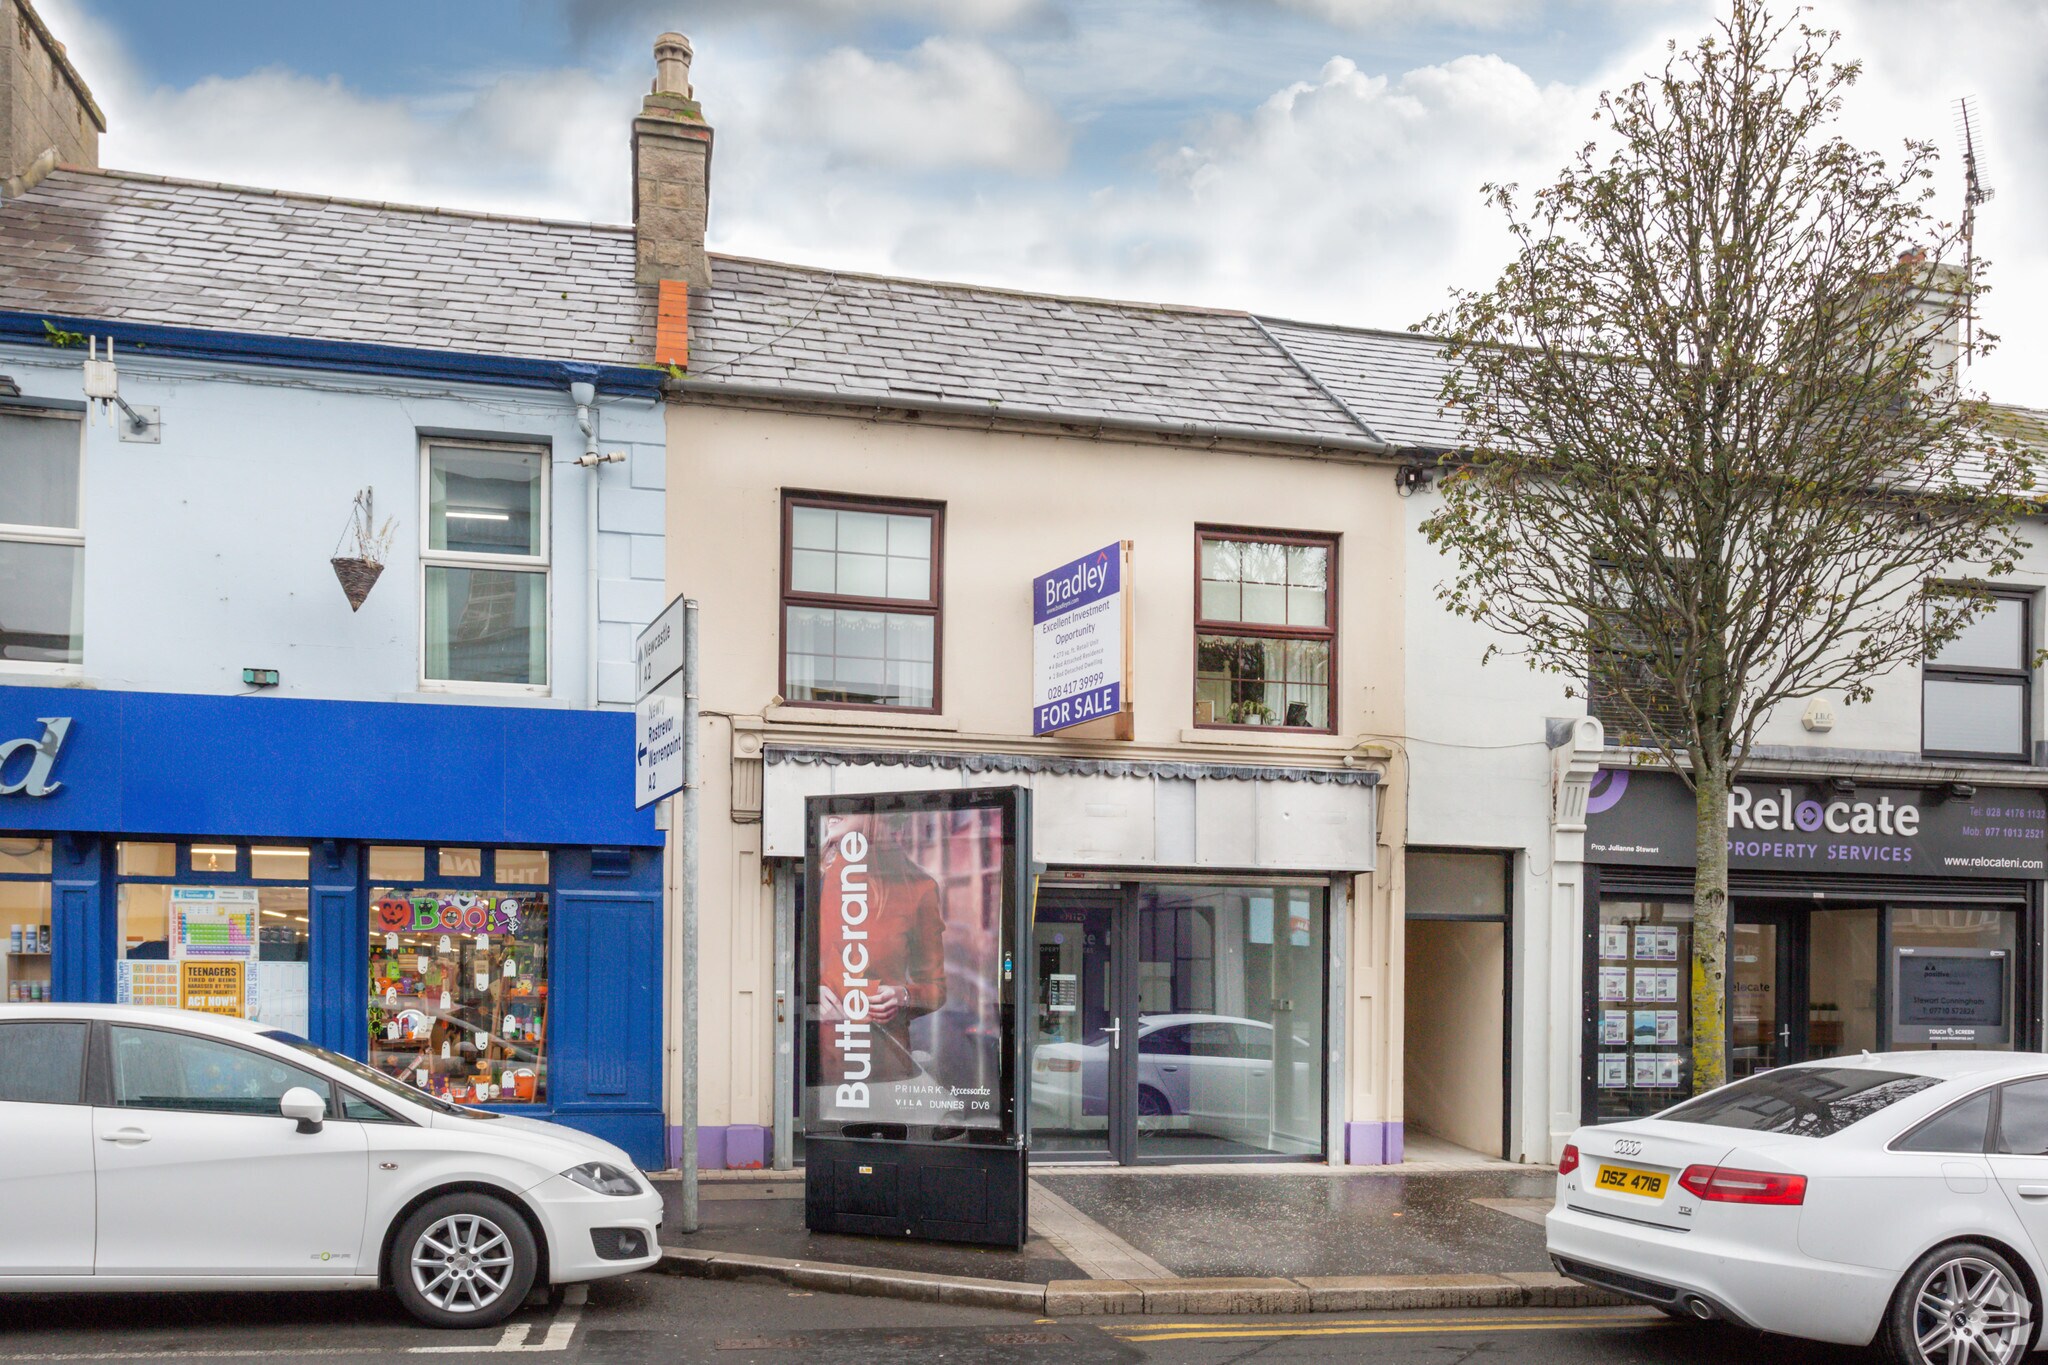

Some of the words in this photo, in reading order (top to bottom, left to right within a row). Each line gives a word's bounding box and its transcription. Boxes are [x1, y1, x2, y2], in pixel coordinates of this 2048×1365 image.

[1046, 561, 1107, 607] Bradley
[1042, 616, 1071, 634] Excellent
[1072, 601, 1110, 623] Investment
[643, 622, 670, 660] Newcastle
[1055, 623, 1096, 645] Opportunity
[1077, 643, 1089, 651] Retail
[1090, 639, 1099, 647] Unit
[1055, 661, 1063, 669] Bed
[1064, 655, 1082, 666] Attached
[1083, 647, 1104, 659] Residence
[1065, 664, 1084, 676] Detached
[1084, 658, 1103, 669] Dwelling
[643, 662, 651, 684] A2
[1047, 685, 1062, 700] 028
[1063, 680, 1078, 694] 417
[1079, 671, 1104, 690] 39999
[1041, 701, 1070, 729] FOR
[1074, 688, 1112, 719] SALE
[648, 716, 673, 743] Rostrevor
[648, 732, 681, 768] Warrenpoint
[648, 771, 656, 792] A2
[1727, 786, 1920, 837] Relocate
[1969, 807, 1984, 816] Tel:
[1986, 808, 2001, 817] 028
[2005, 808, 2025, 818] 4176
[2027, 809, 2046, 819] 1132
[1962, 826, 1981, 836] Mob:
[1985, 827, 2000, 836] 077
[2003, 828, 2022, 838] 1013
[2025, 829, 2044, 838] 2521
[1591, 843, 1607, 852] Prop.
[1608, 844, 1634, 852] Julianne
[1635, 845, 1659, 853] Stewart
[1727, 841, 1818, 859] PROPERTY
[1827, 844, 1912, 862] SERVICES
[1944, 856, 2043, 869] www.relocateni.com
[188, 967, 236, 976] TEENAGERS
[247, 962, 257, 982] TIMES
[835, 831, 871, 1109] Buttercrane
[188, 996, 206, 1006] ACT
[208, 996, 236, 1006] NOW!!
[247, 983, 257, 1006] TABLES
[895, 1084, 942, 1094] PRIMARK
[950, 1085, 991, 1096] Accessorize
[929, 1100, 964, 1109] DUNNES
[971, 1101, 990, 1110] DV8
[1601, 1170, 1627, 1186] DSZ
[1631, 1176, 1662, 1192] 4718
